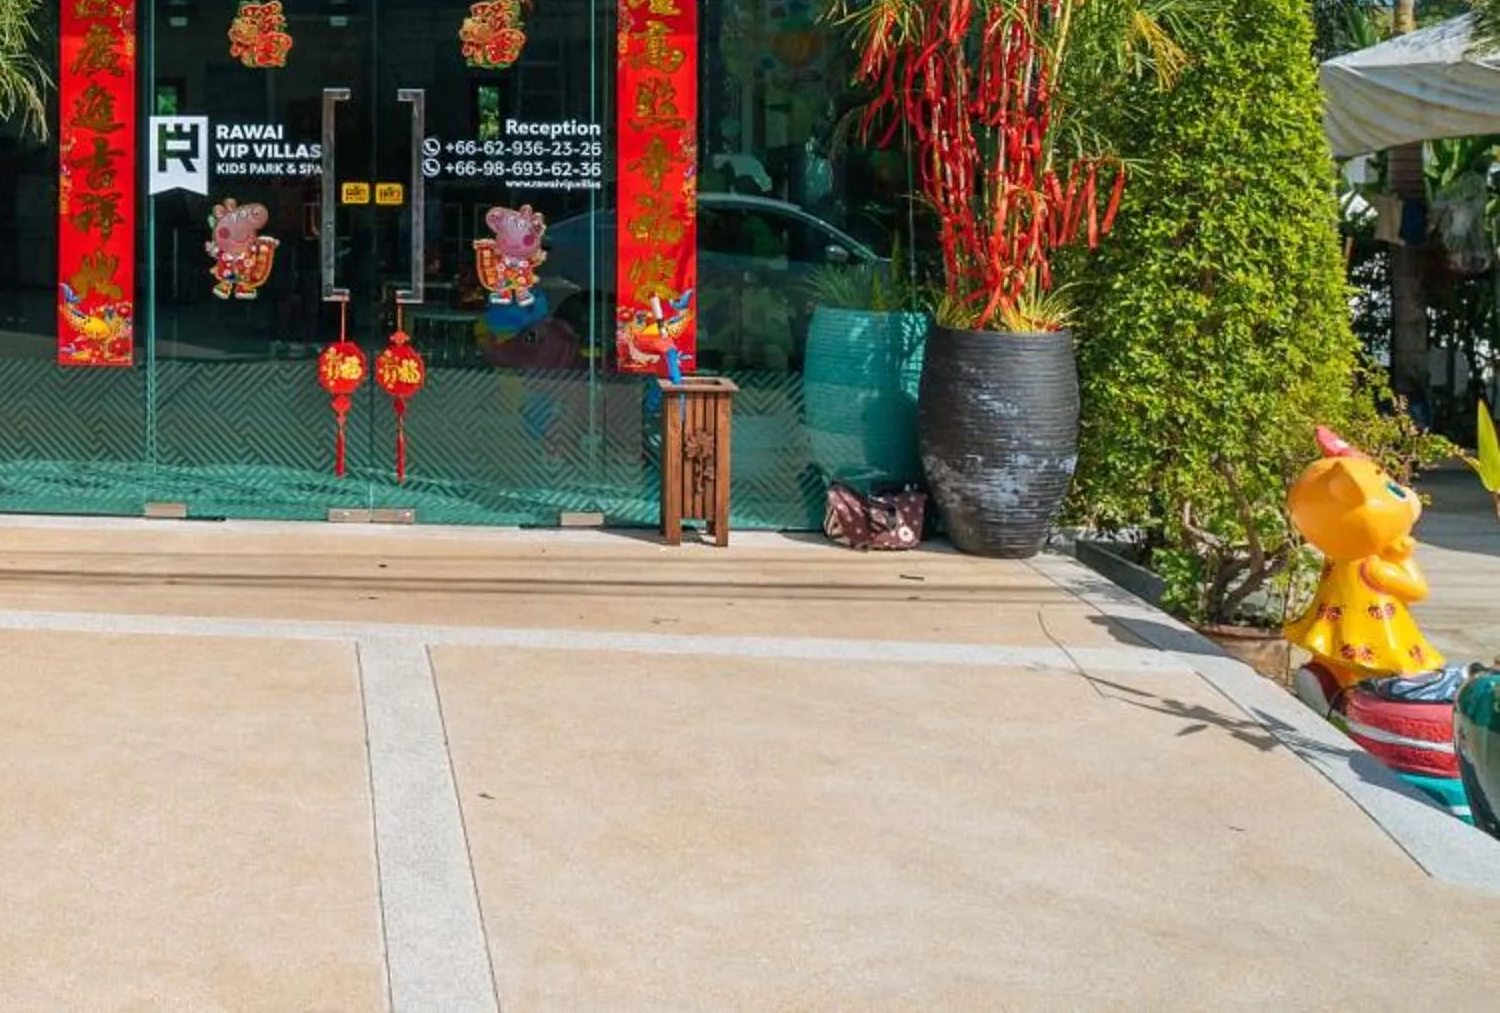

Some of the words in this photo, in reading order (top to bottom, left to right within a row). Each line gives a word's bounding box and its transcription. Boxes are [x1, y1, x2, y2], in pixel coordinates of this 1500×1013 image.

[215, 124, 284, 140] RAWAI
[505, 118, 601, 139] Reception
[215, 143, 249, 159] VIP
[253, 143, 323, 159] VILLAS
[445, 140, 602, 157] +66-62-936-23-26
[216, 162, 247, 175] KIDS
[250, 162, 284, 175] PARK
[286, 162, 297, 174] &
[298, 162, 324, 175] SPA
[445, 160, 602, 177] +66-98-693-62-36
